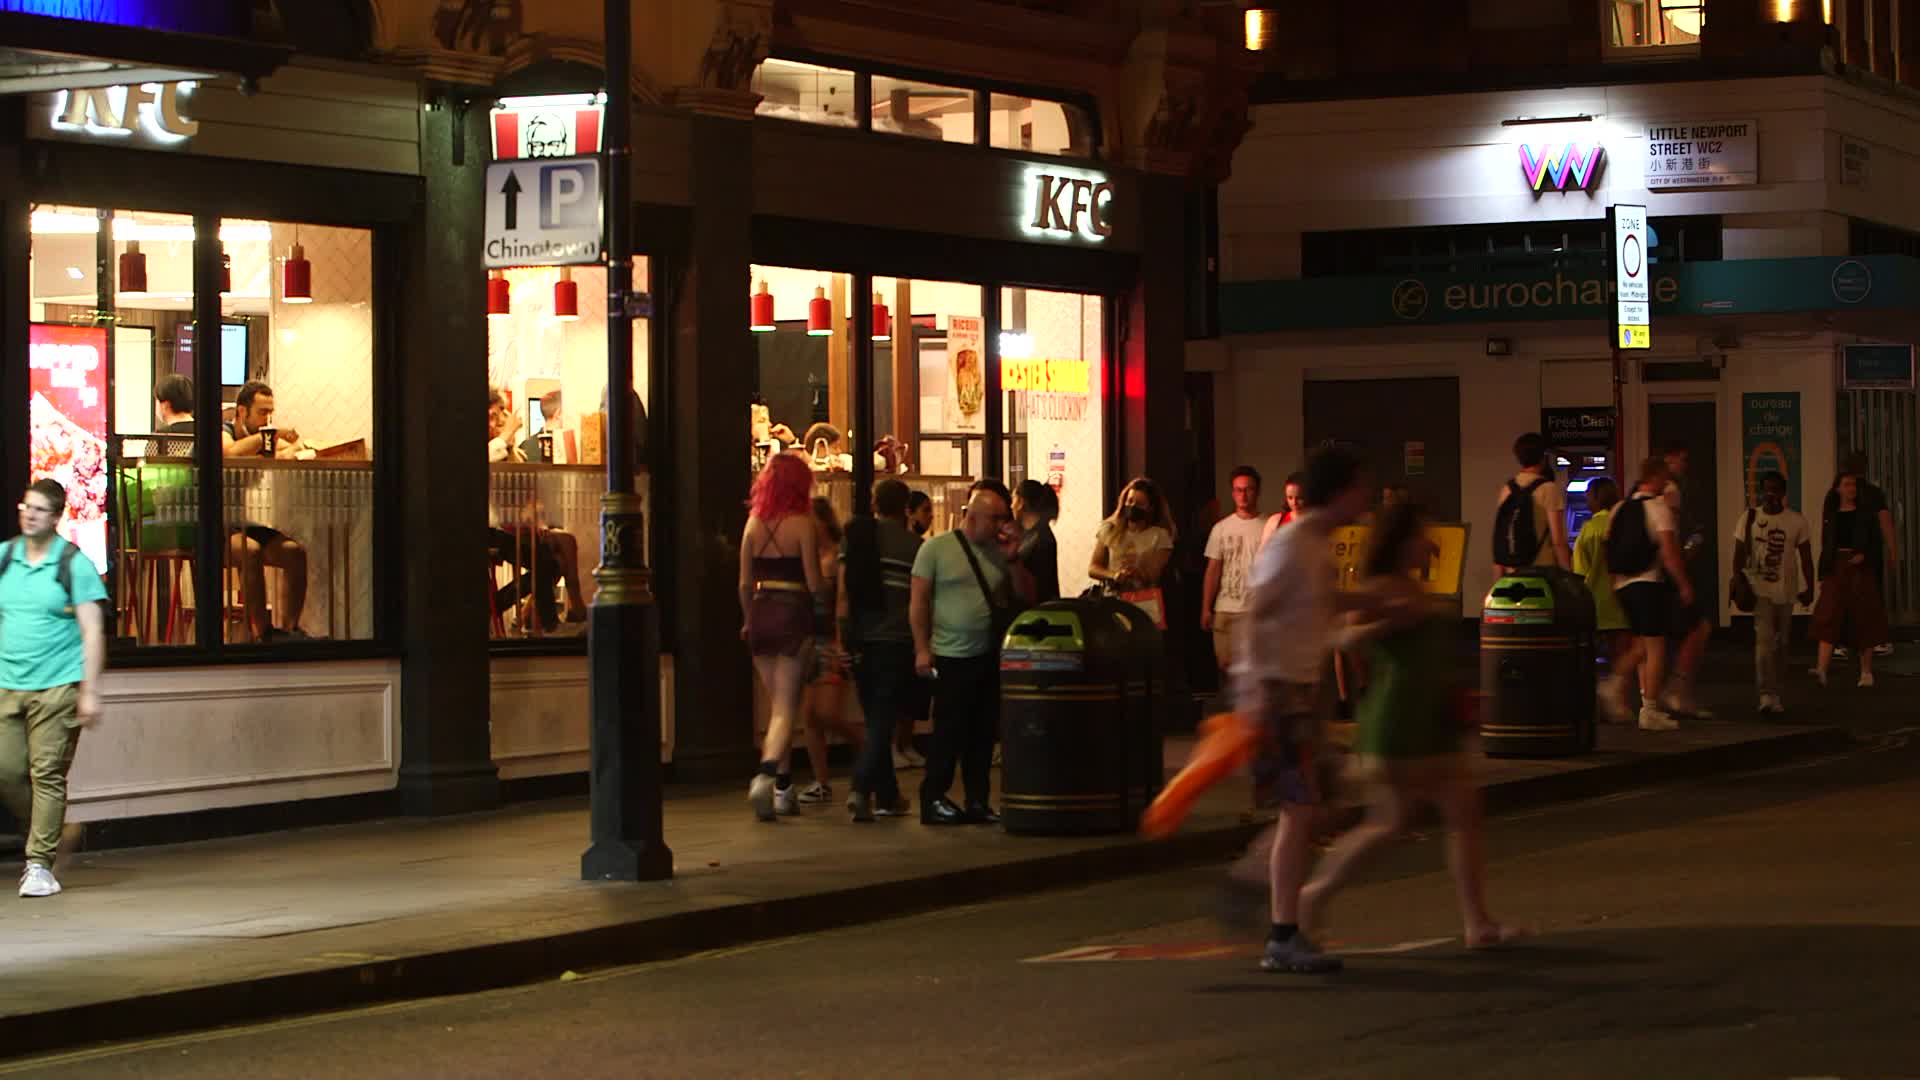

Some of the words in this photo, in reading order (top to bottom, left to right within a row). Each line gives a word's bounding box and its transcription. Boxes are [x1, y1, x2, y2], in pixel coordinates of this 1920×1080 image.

[57, 80, 200, 136] KFC
[1649, 127, 1687, 141] LITTLE
[1691, 124, 1748, 139] NEWPORT
[1650, 142, 1692, 156] STREET
[1697, 141, 1722, 154] WC2
[551, 168, 585, 226] P
[1031, 174, 1114, 237] KFC
[1621, 218, 1640, 230] ZONE
[486, 237, 596, 260] Chinatown
[1443, 273, 1679, 311] eurochae
[1547, 414, 1577, 431] Free
[1580, 413, 1615, 430] Cash
